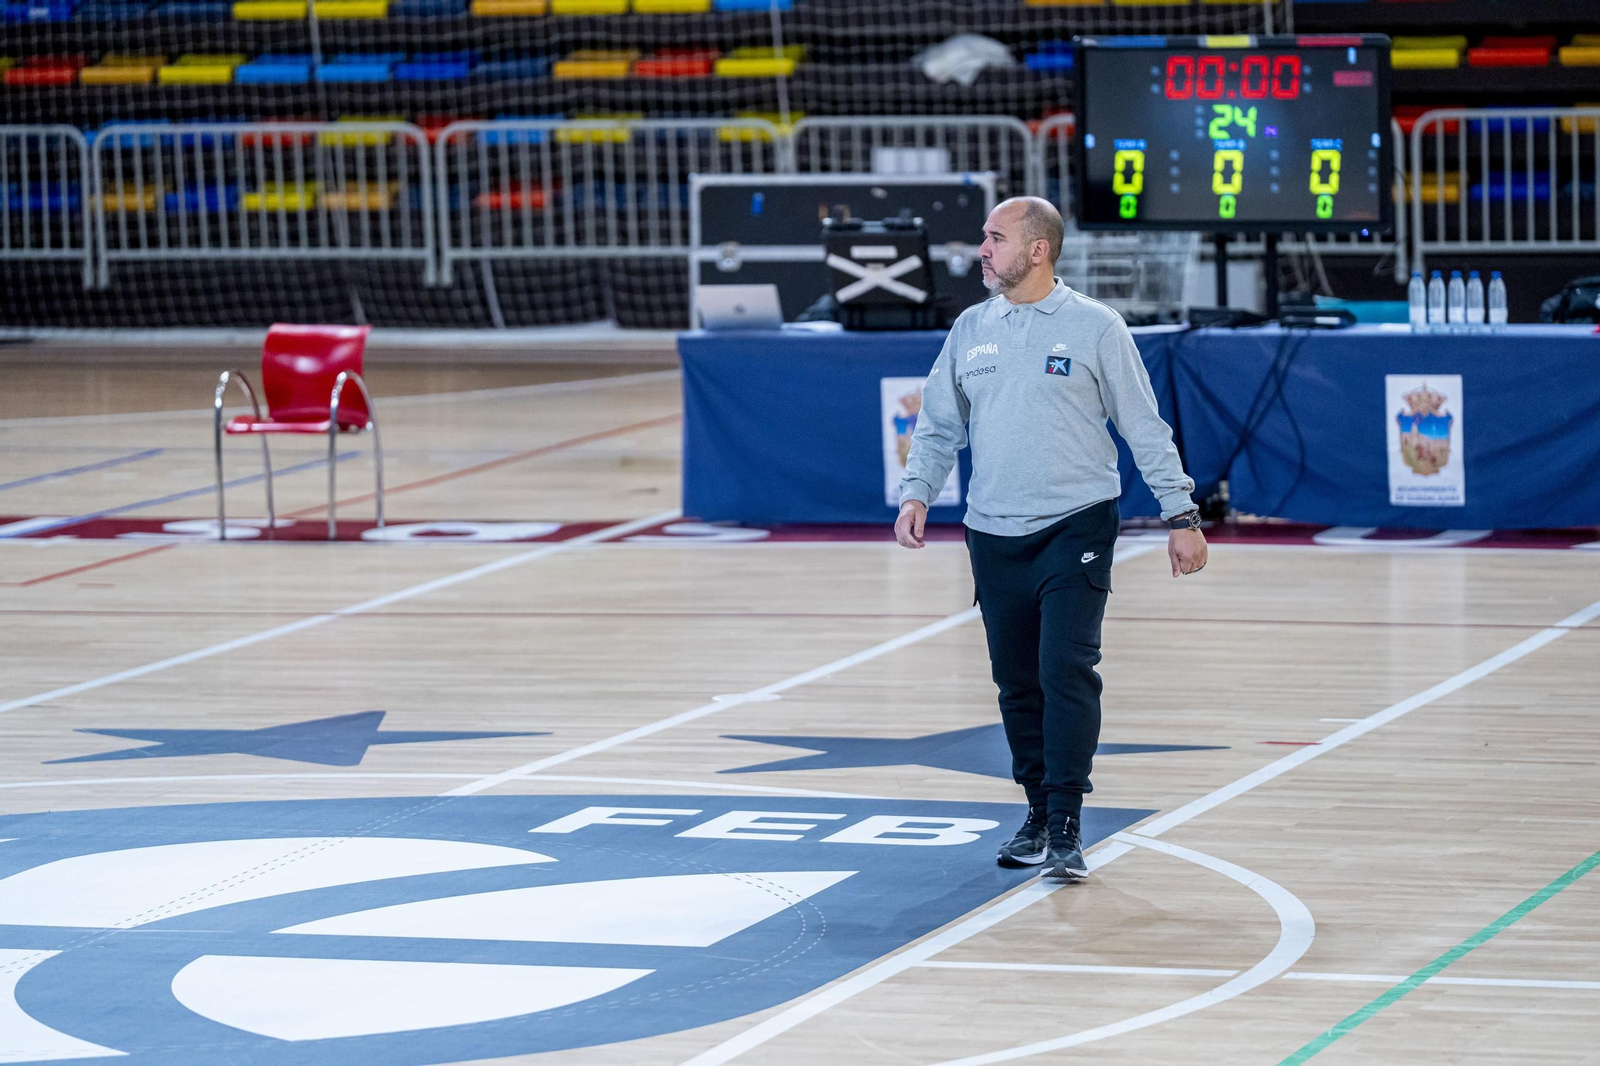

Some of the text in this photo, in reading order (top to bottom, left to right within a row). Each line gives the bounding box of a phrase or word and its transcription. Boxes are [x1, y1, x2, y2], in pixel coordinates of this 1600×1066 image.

[1164, 55, 1301, 100] 00:00
[1209, 104, 1258, 139] 24
[1112, 149, 1145, 195] 0
[1212, 149, 1245, 195] 0
[1309, 149, 1342, 195] 0
[1119, 195, 1138, 219] 0
[1218, 195, 1237, 219] 0
[1316, 195, 1333, 219] 0
[966, 341, 999, 362] ESPAÑA
[528, 806, 1000, 847] FEB
